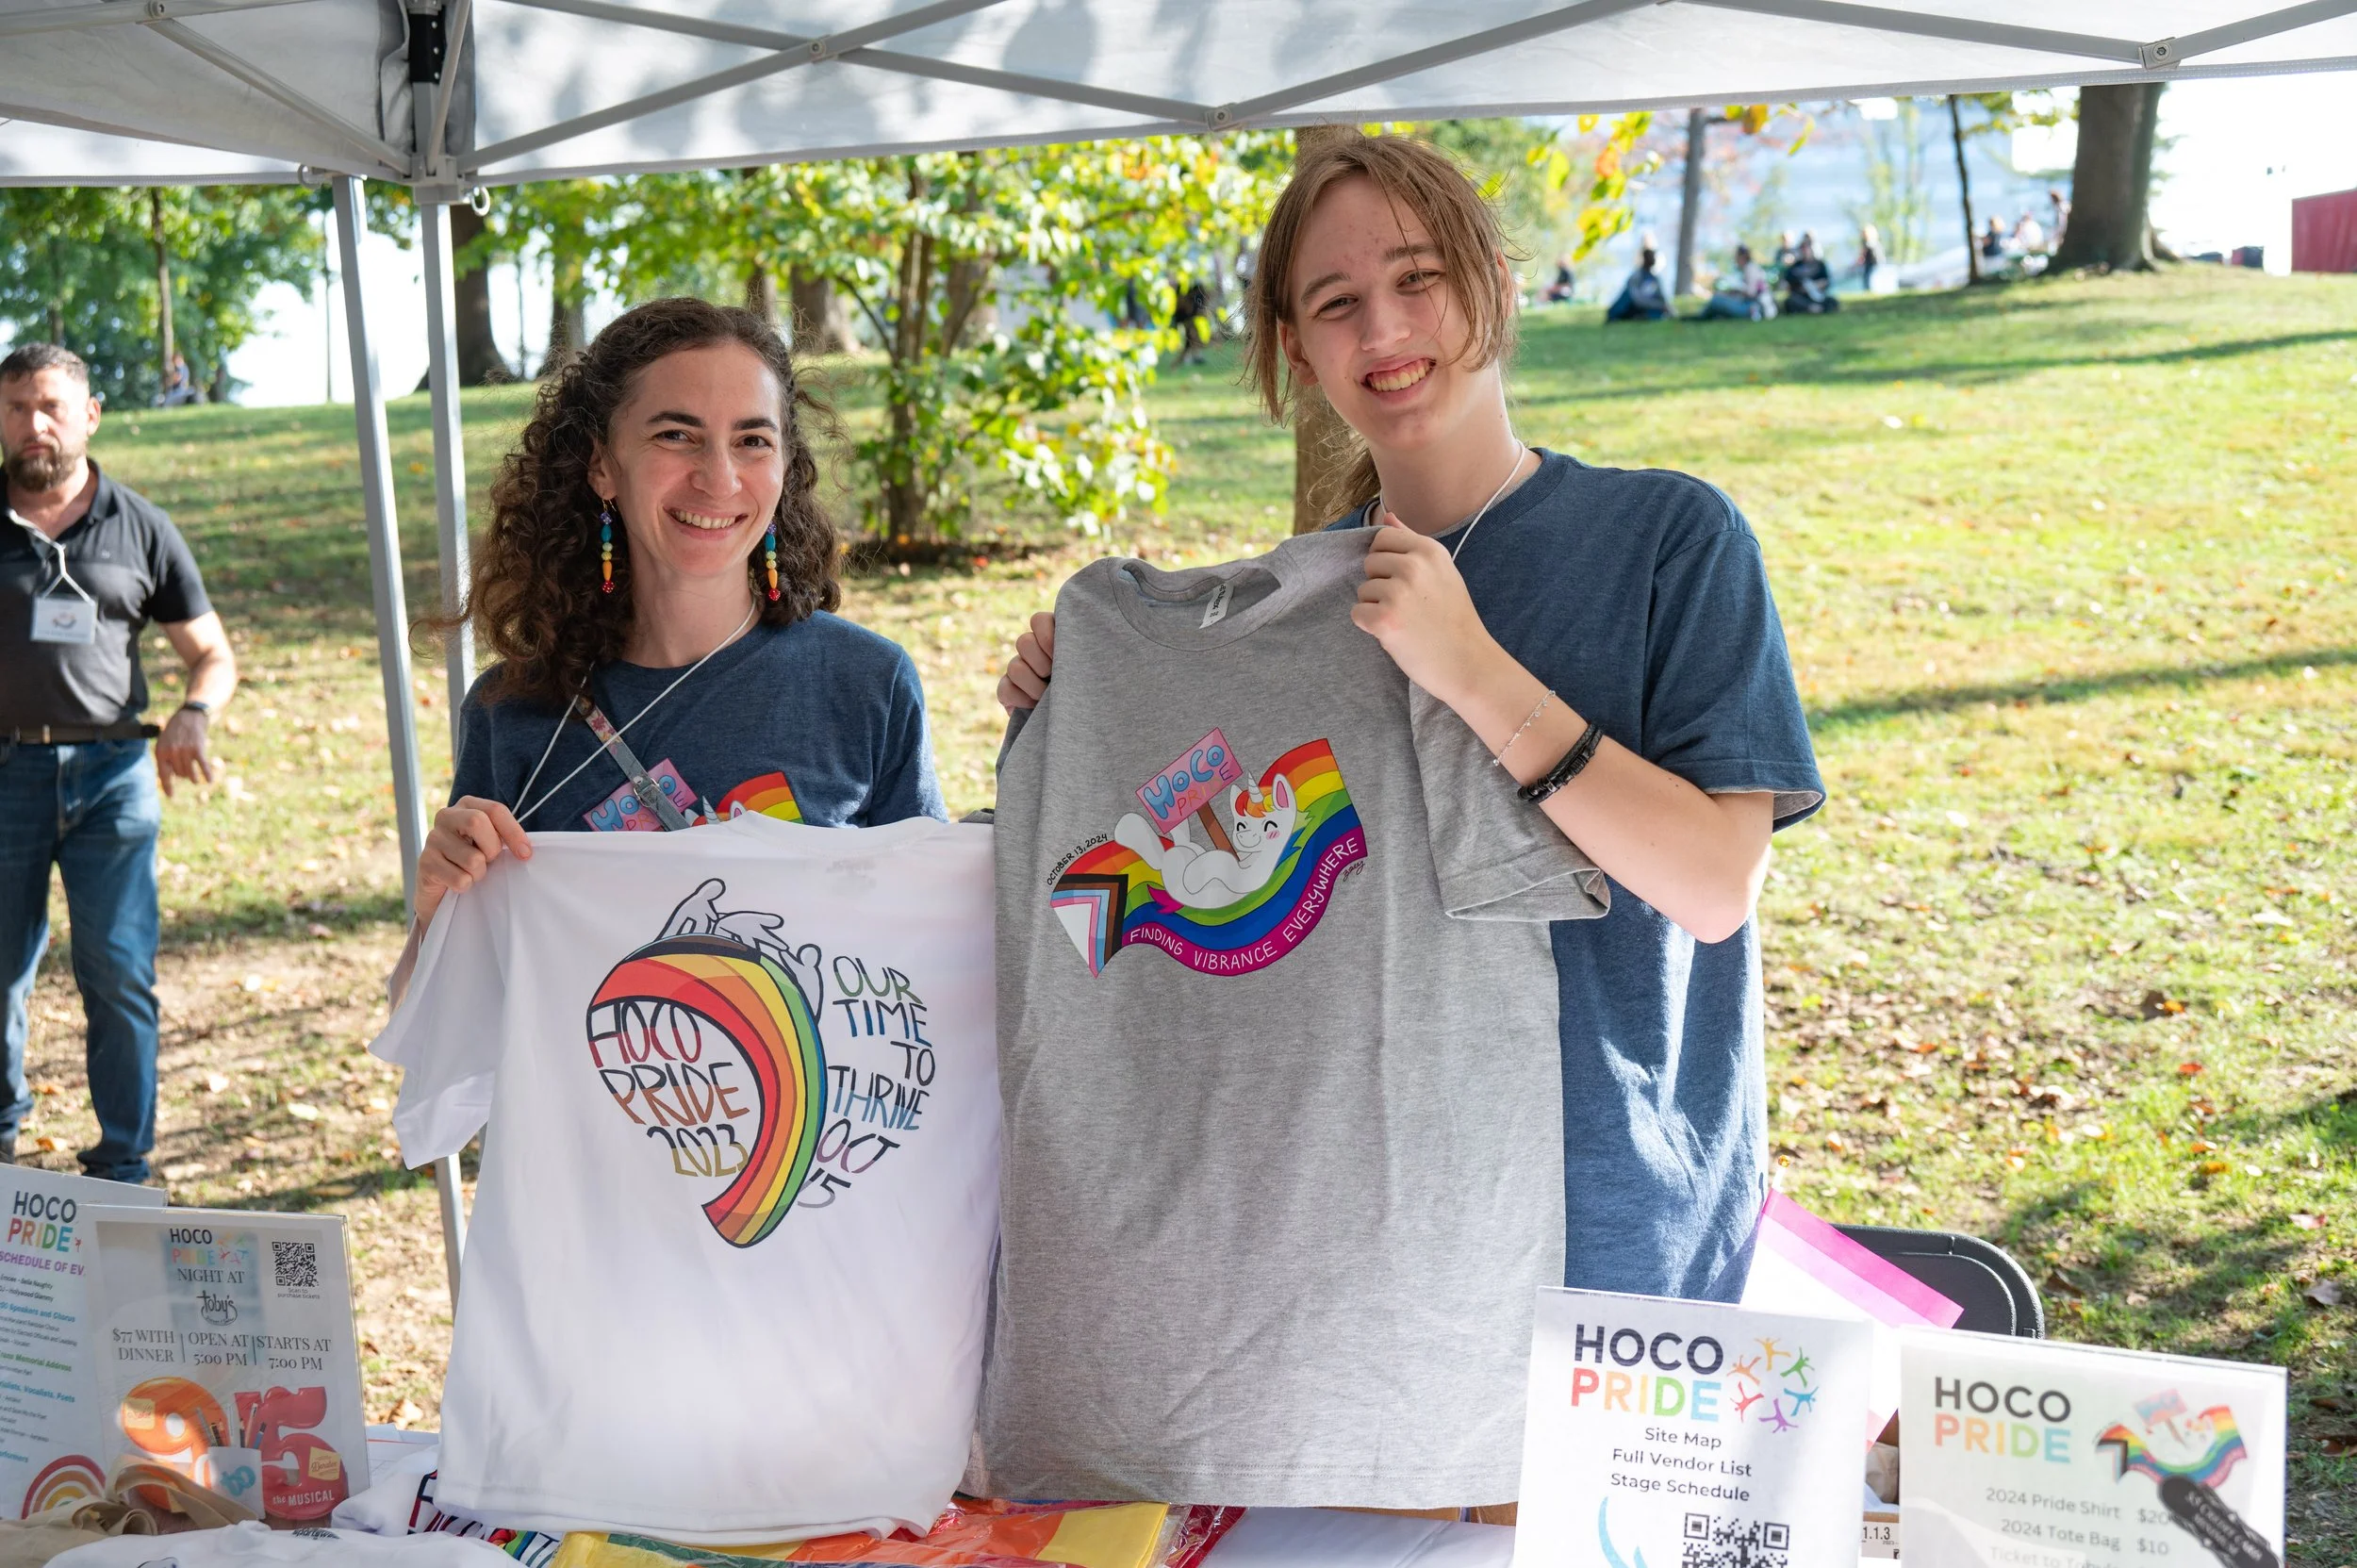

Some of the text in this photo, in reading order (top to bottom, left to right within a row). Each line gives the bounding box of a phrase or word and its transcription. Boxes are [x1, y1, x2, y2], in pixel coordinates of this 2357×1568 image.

[1178, 762, 1232, 817] PRIDE
[1047, 852, 1075, 885] OCTOBER
[1085, 834, 1108, 848] 2024
[1130, 837, 1358, 969] FINDING VIBRANCE EVERYWHERE
[833, 956, 923, 1004] OUR
[587, 1001, 701, 1067] HOCO
[832, 999, 932, 1048] TIME
[891, 1041, 935, 1086] TO
[599, 1063, 750, 1127] PRIDE
[828, 1065, 930, 1131] THRIVE
[647, 1124, 750, 1178] 2023
[816, 1118, 900, 1174] OCT
[13, 1191, 76, 1223] HOCO
[8, 1217, 73, 1252] PRIDE
[170, 1229, 212, 1244] HOCO
[0, 1251, 86, 1277] SCHEDULE OF EV
[172, 1248, 215, 1265] PRIDE
[177, 1268, 244, 1283] NIGHT AT
[113, 1329, 175, 1344] $77 WITH
[119, 1347, 174, 1362] DINNER
[189, 1332, 250, 1348] OPEN AT
[256, 1336, 331, 1352] STARTS AT
[1574, 1324, 1723, 1375] HOCO
[193, 1353, 248, 1366] 5:00 PM
[269, 1357, 322, 1370] 7:00 PM
[1571, 1367, 1722, 1422] PRIDE
[1935, 1377, 2071, 1423] HOCO
[1644, 1428, 1722, 1450] Site Map
[1935, 1413, 2071, 1463] PRIDE
[1613, 1448, 1753, 1477] Full Vendor List
[272, 1490, 335, 1506] the MUSICAL
[1610, 1473, 1751, 1502] Stage Schedule
[1986, 1487, 2168, 1526] 2024 Pride Shirt $20
[2001, 1519, 2168, 1556] 2024 Tote Bag $10
[1990, 1545, 2036, 1565] Ticket
[2043, 1554, 2063, 1568] to
